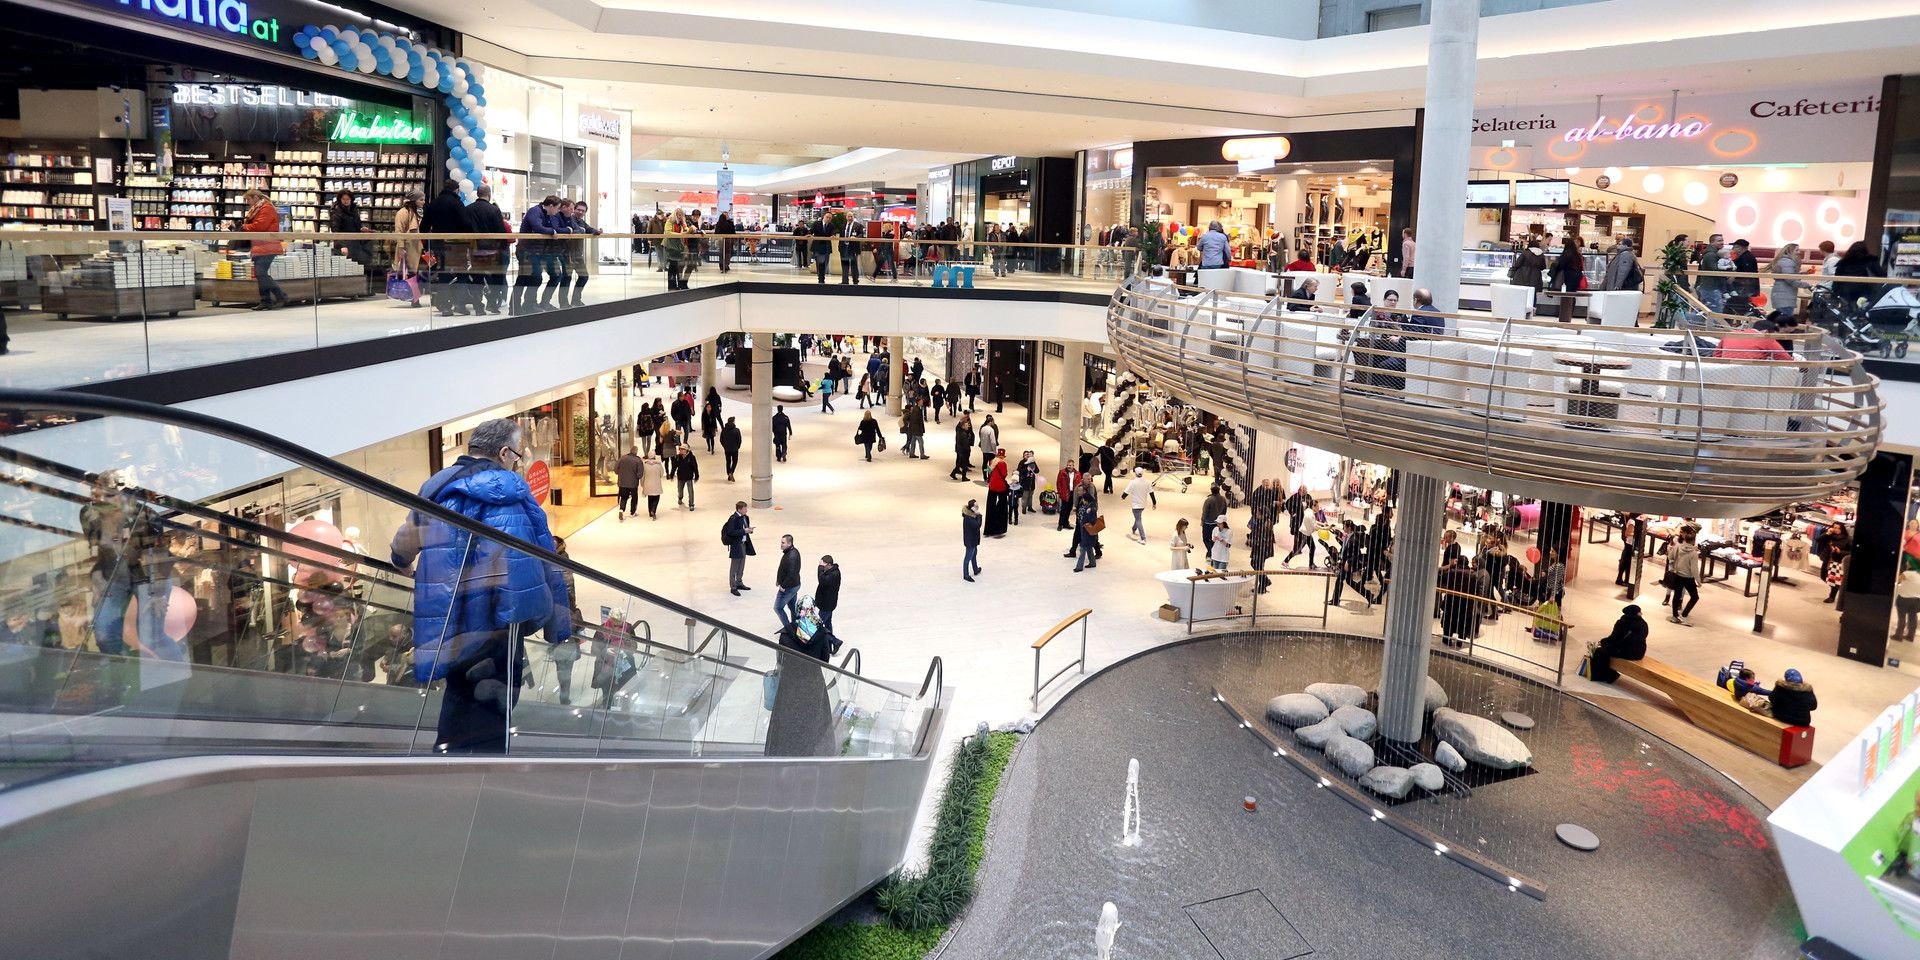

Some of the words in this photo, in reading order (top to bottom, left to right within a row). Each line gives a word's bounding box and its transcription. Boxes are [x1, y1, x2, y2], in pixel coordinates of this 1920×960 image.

[331, 112, 424, 141] Neuheiten
[1564, 113, 1712, 143] al-bano
[991, 156, 1016, 171] DEPOT
